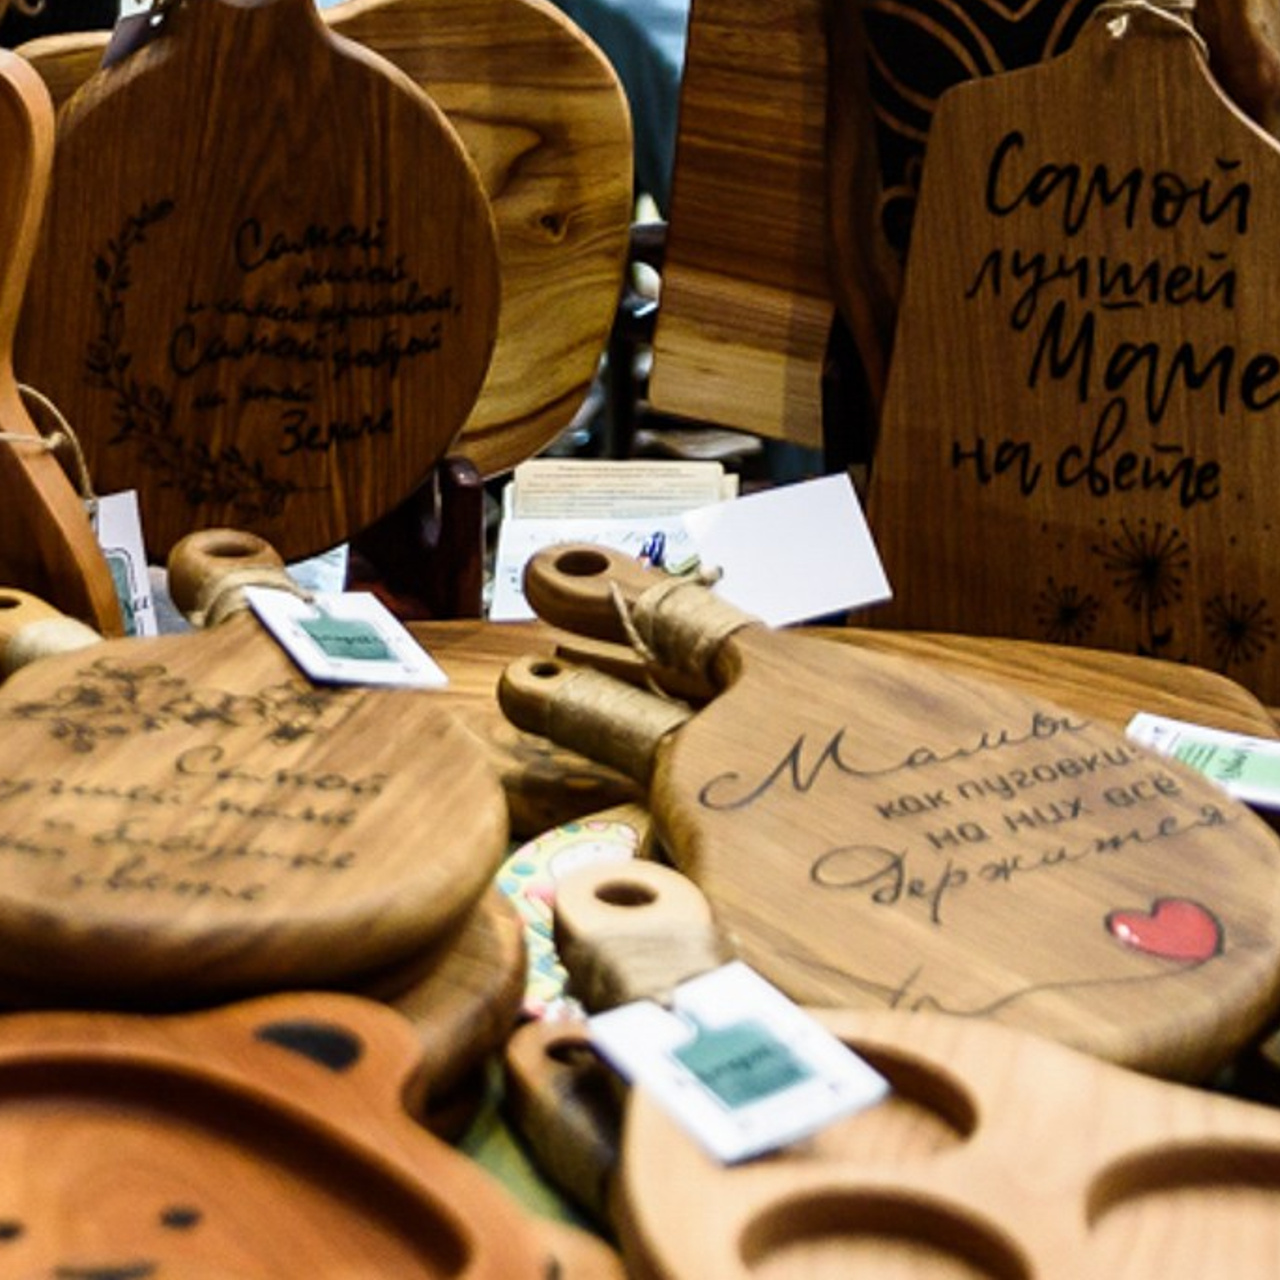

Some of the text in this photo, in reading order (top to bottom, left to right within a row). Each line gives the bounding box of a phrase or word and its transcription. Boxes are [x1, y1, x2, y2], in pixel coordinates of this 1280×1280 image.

[985, 130, 1251, 234] Самой
[234, 217, 387, 271] Самой
[965, 248, 1236, 331] лучшей
[170, 324, 327, 378] Самой
[1028, 300, 1280, 426] Маме
[952, 397, 1221, 509] на свете
[698, 710, 1094, 811] Мамы
[874, 783, 953, 821] как
[923, 819, 993, 851] на
[1002, 794, 1091, 833] них
